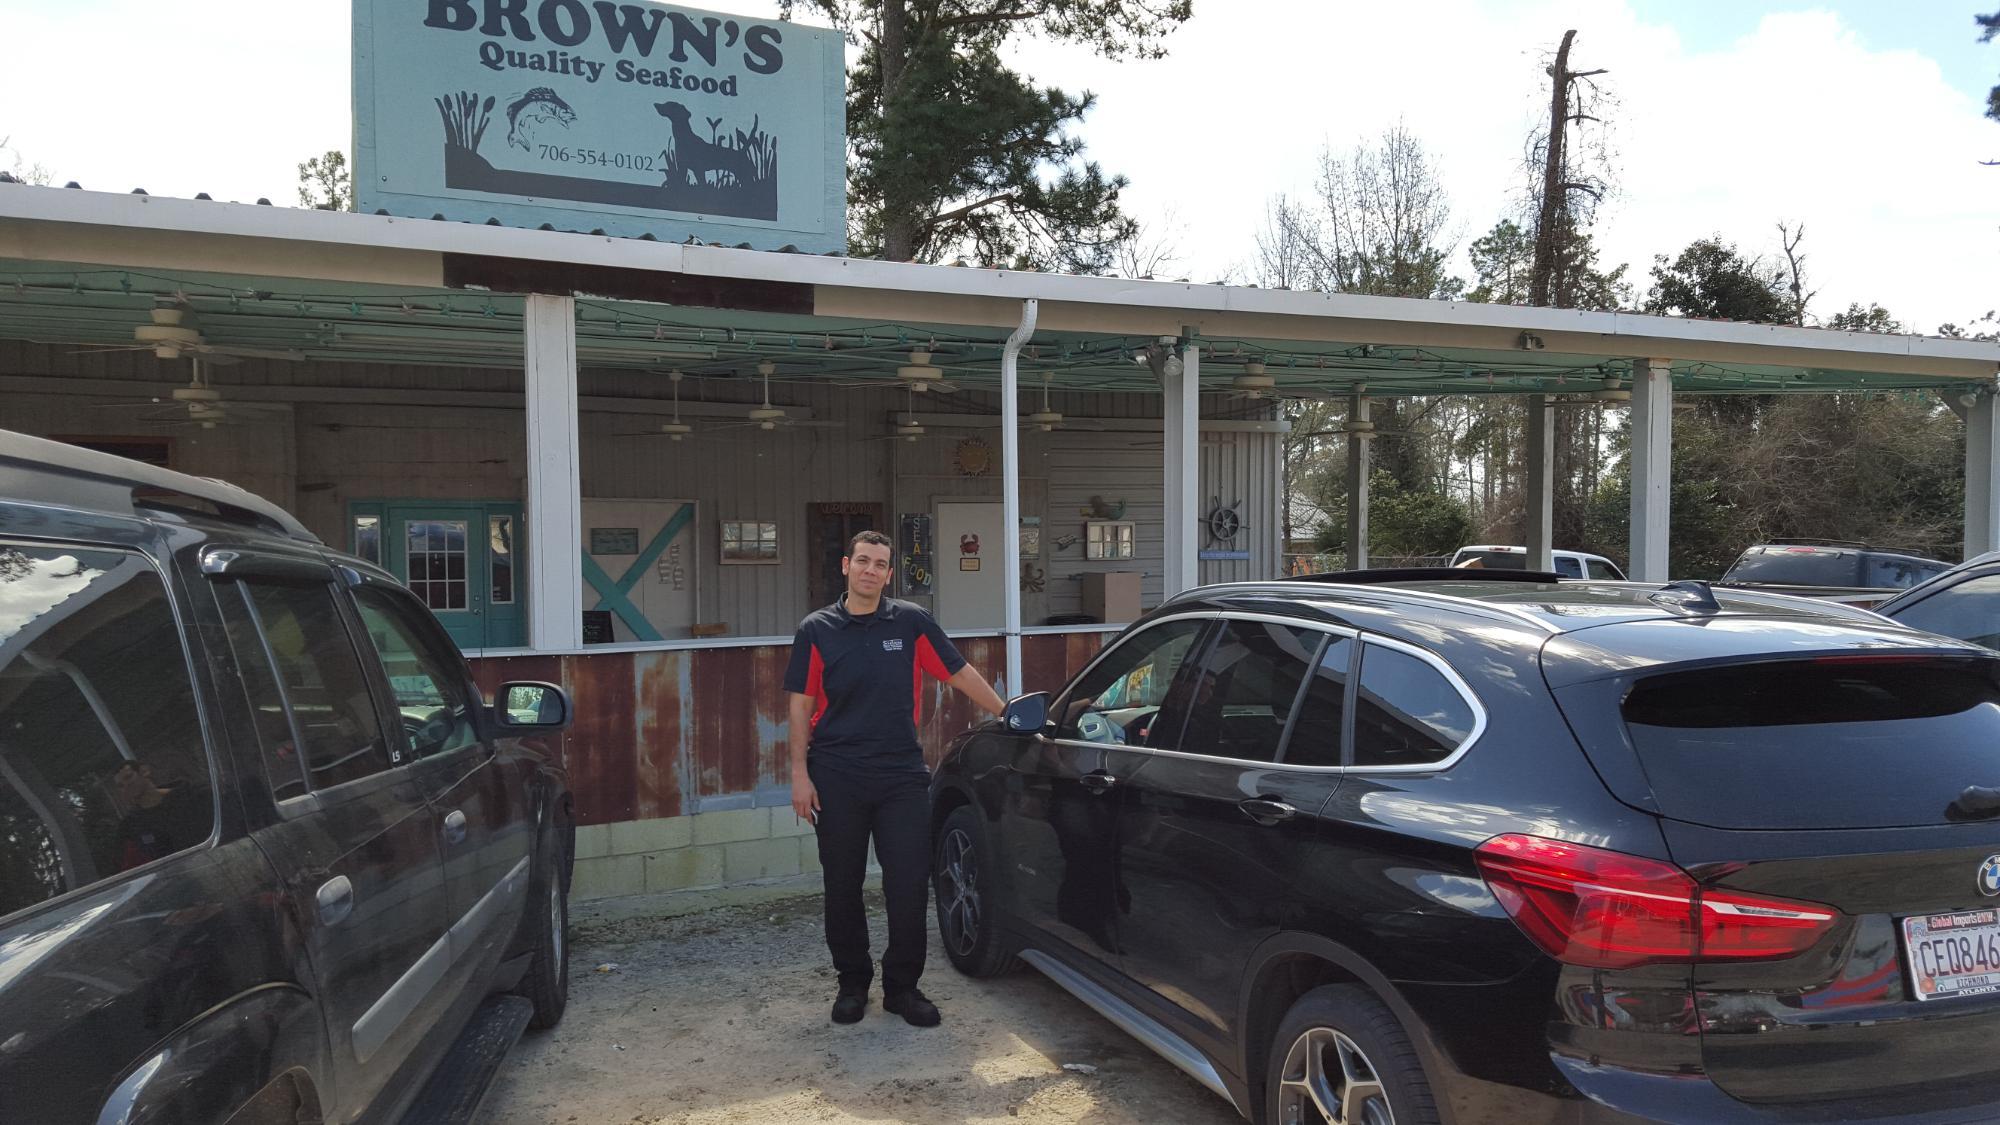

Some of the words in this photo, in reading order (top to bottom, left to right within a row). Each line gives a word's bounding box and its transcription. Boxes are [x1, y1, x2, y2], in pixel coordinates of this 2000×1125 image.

[424, 0, 784, 75] BROWN'S
[479, 40, 605, 83] Quality
[615, 59, 738, 97] Seafood
[538, 143, 654, 172] 706-554-0102
[902, 556, 932, 586] FOOD
[1931, 916, 1953, 929] Global
[1952, 913, 1977, 928] Imports
[1919, 931, 2000, 978] CEQ846
[1958, 985, 1997, 996] ATLANTA
